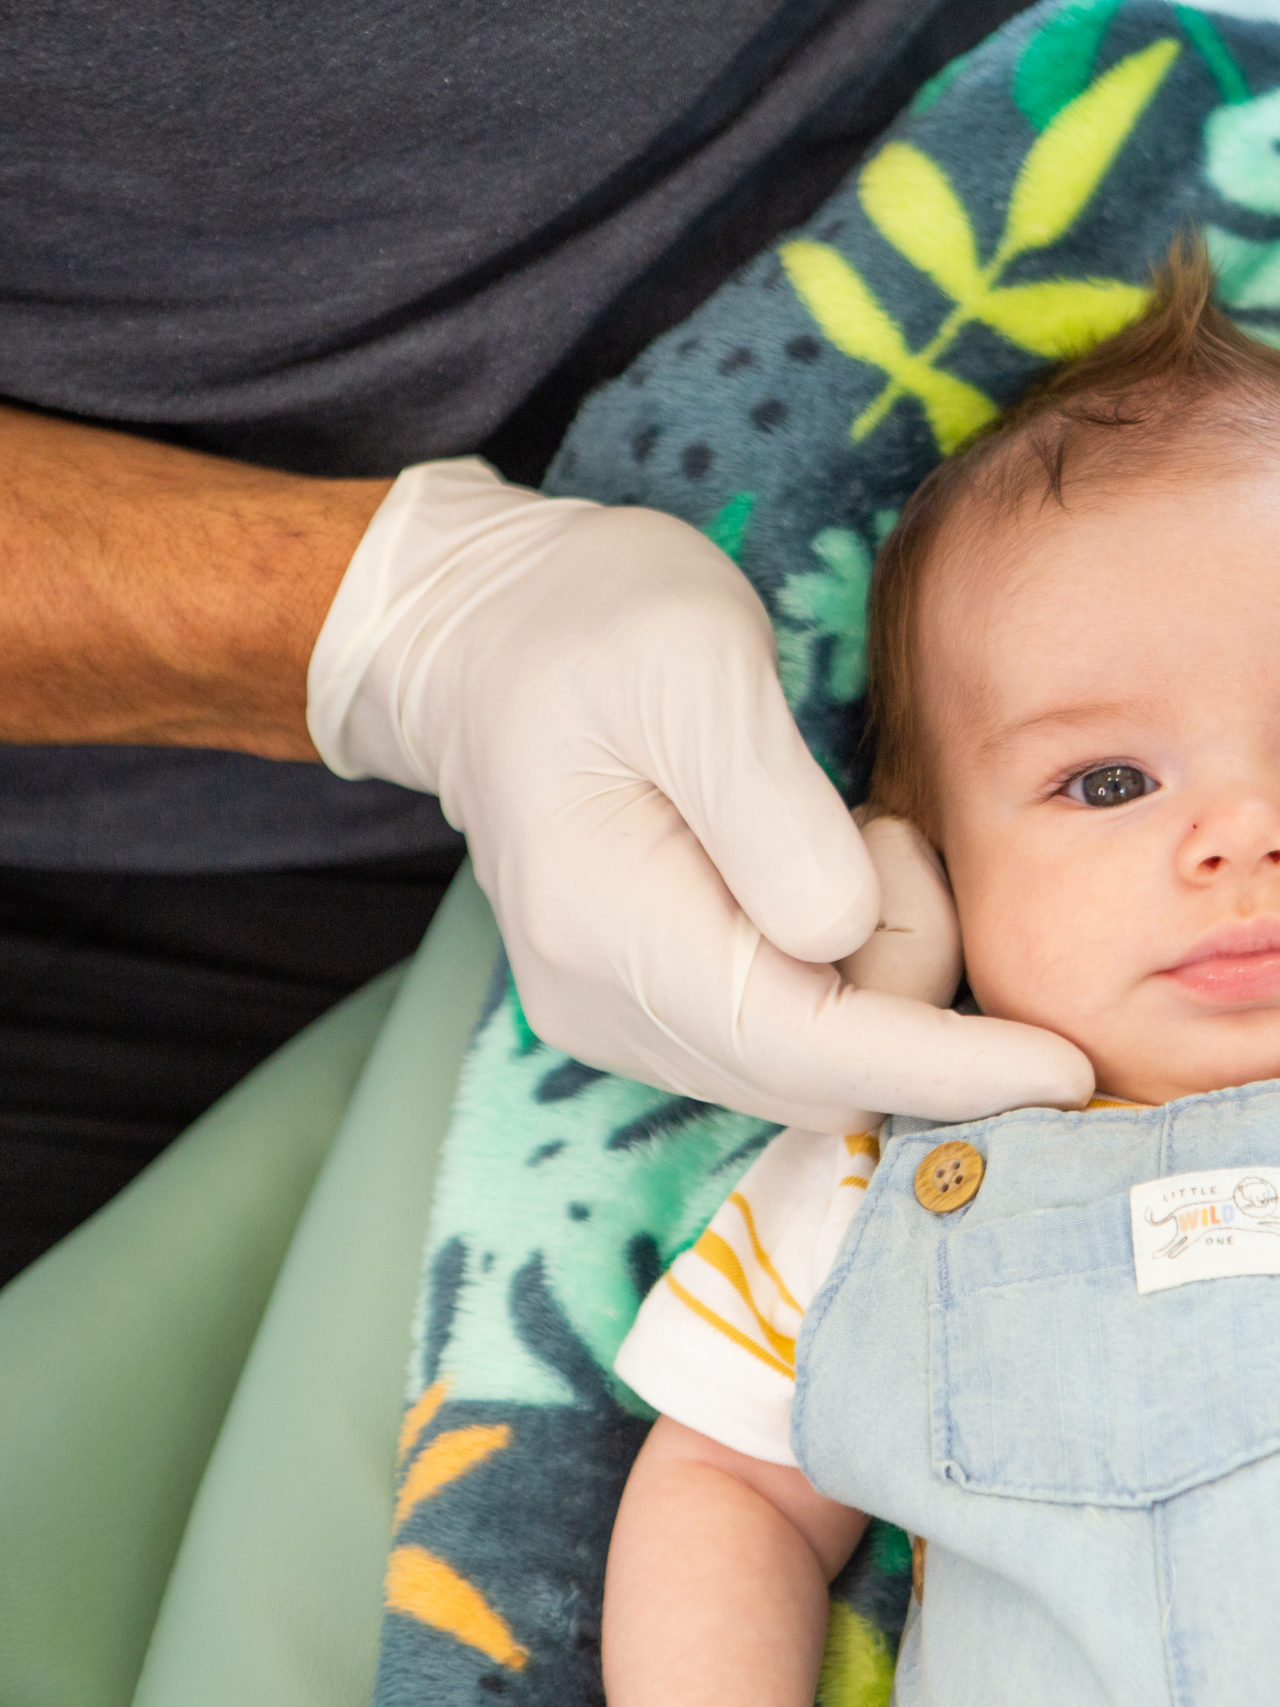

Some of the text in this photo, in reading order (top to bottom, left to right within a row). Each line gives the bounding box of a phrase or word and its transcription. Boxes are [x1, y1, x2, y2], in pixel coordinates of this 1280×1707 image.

[1163, 1186, 1218, 1201] LITTLE
[1179, 1204, 1235, 1232] WILD
[1205, 1236, 1234, 1246] ONE
